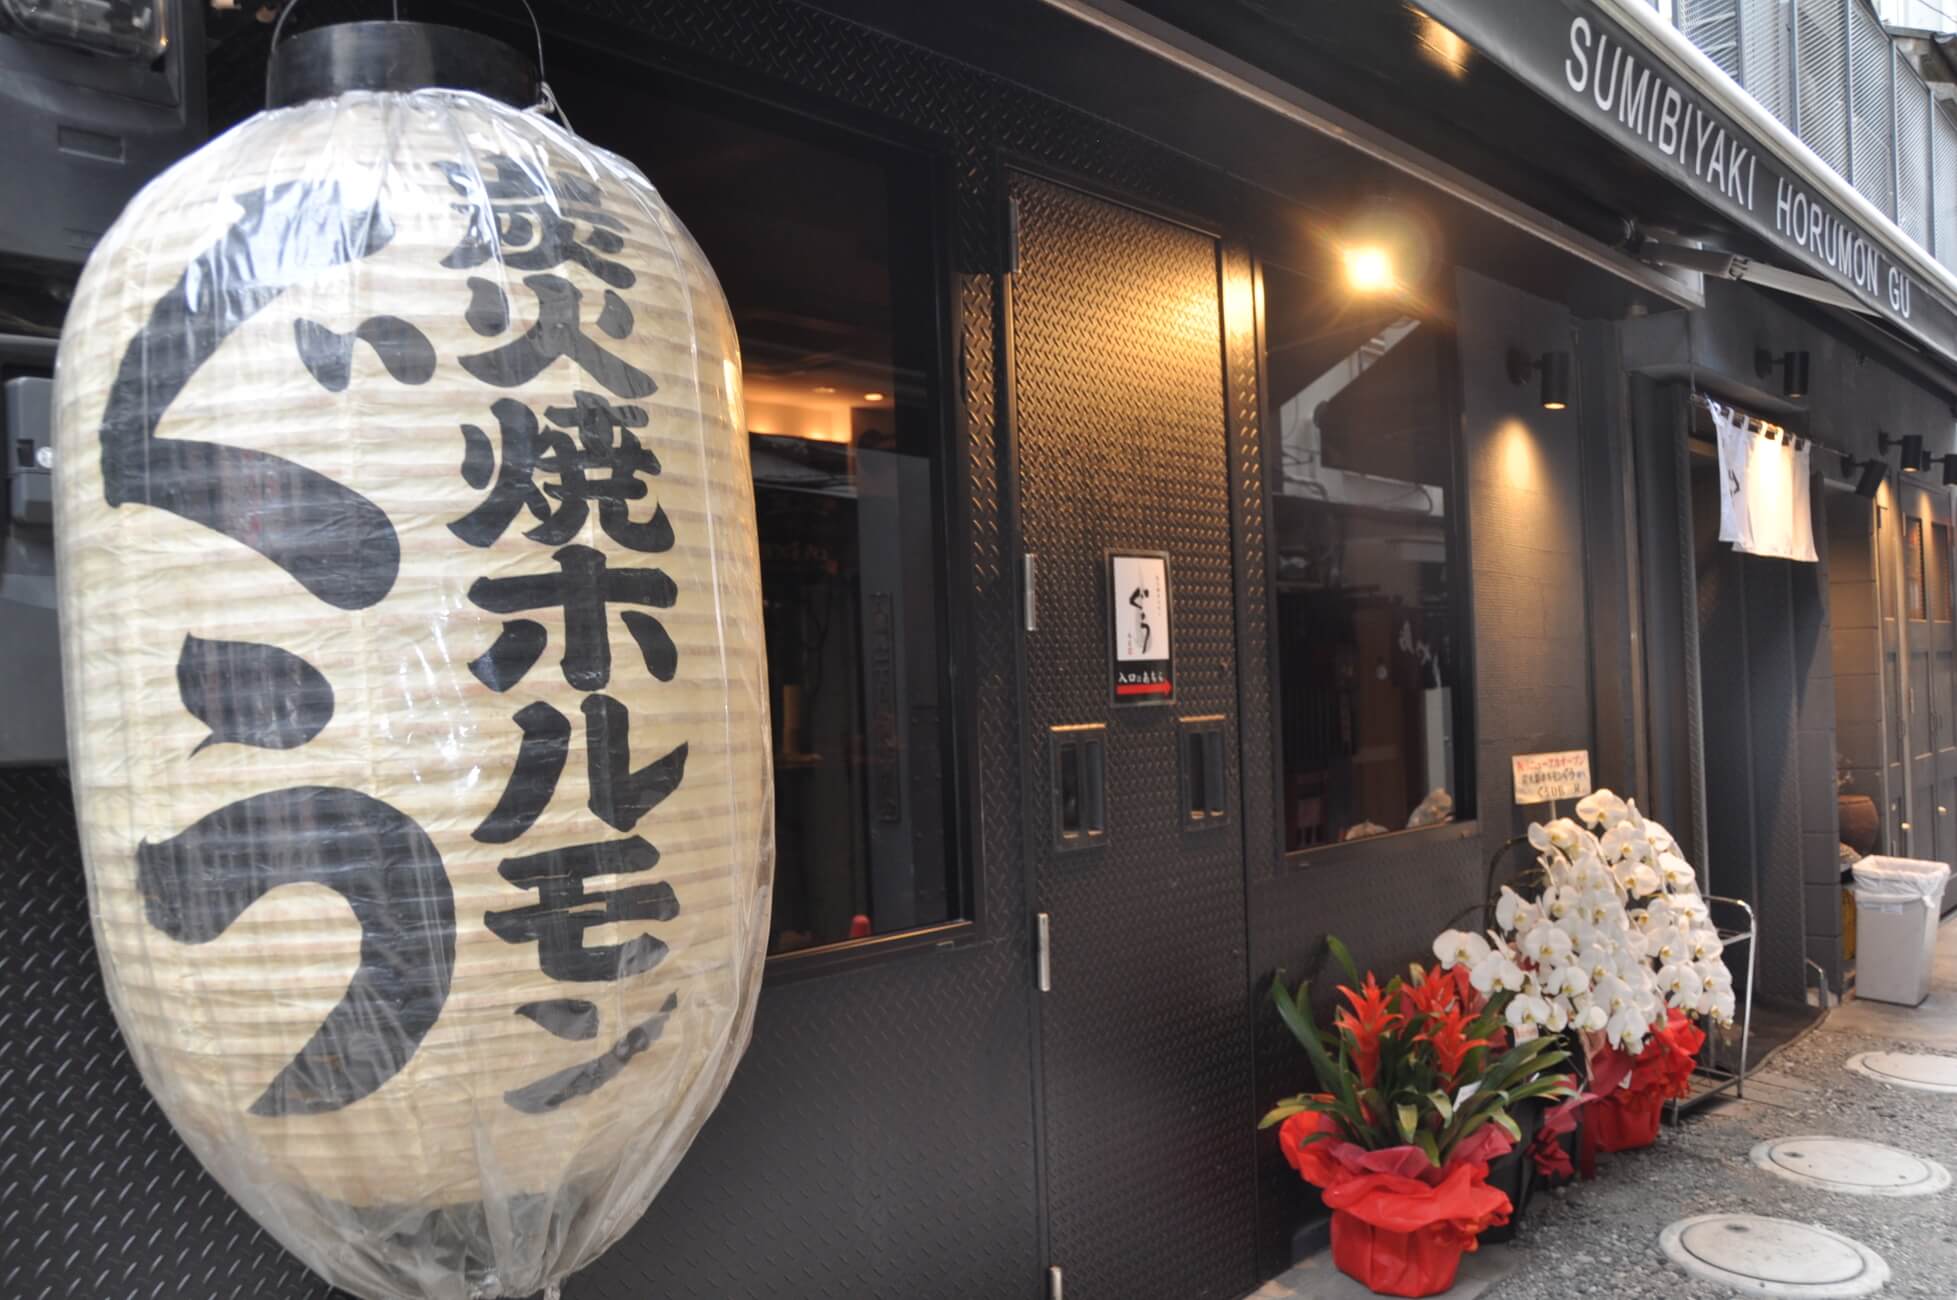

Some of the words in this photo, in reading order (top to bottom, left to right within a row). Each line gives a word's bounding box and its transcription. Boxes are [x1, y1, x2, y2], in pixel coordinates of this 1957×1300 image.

[438, 152, 688, 1114] 炭火焼ホルモン
[1565, 17, 1756, 211] SUMIBIYAKI
[1776, 176, 1879, 297] HORUMON
[1888, 267, 1911, 318] GU
[100, 180, 457, 1117] ぐう
